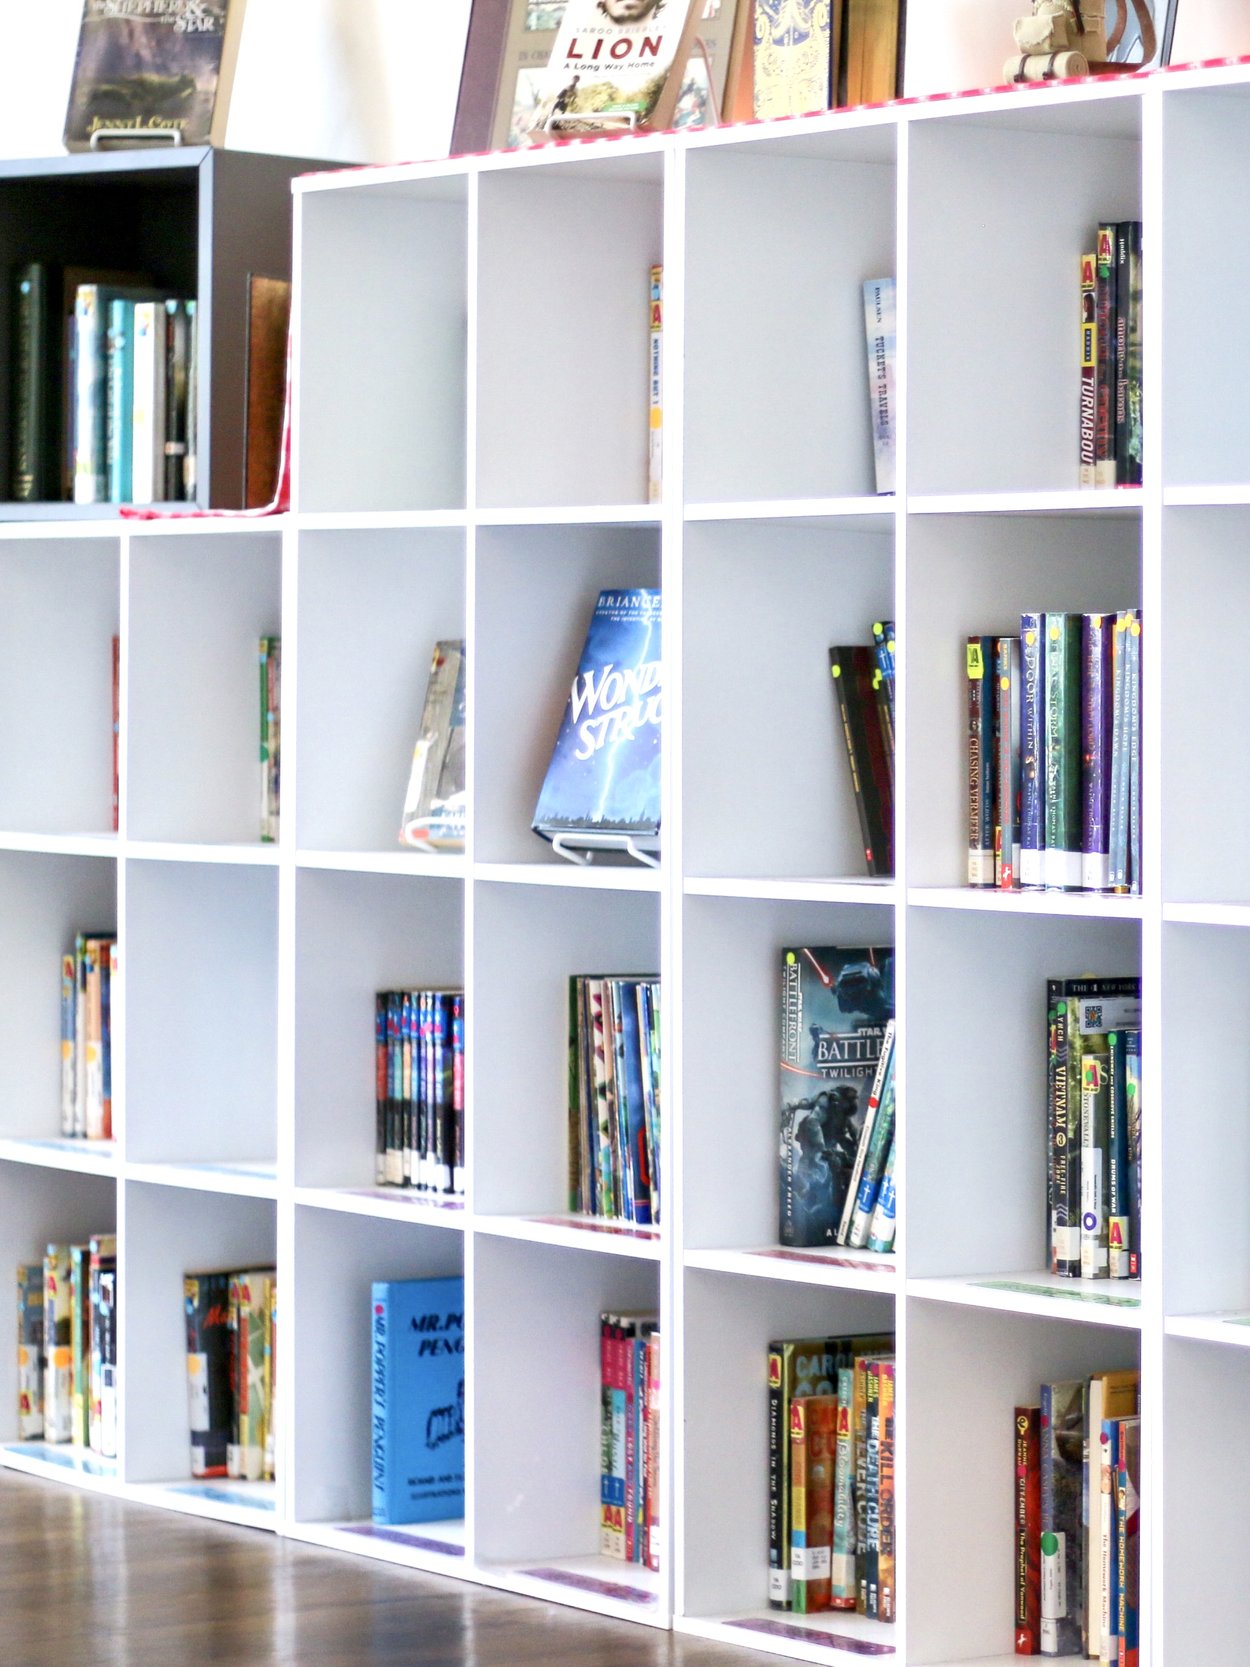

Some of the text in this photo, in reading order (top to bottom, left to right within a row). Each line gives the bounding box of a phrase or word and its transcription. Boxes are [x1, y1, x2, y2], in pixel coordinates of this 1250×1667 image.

[567, 36, 663, 60] LION
[574, 63, 600, 71] Long
[970, 737, 979, 840] CHASING VERMEER
[788, 962, 798, 1063] BATTLEFRONT
[1055, 1065, 1068, 1129] VIETNAM
[1110, 1159, 1118, 1214] DRUMS OF WAR
[770, 1399, 779, 1450] DIAMONDS
[770, 1475, 779, 1492] THE
[867, 1416, 881, 1552] THE DEATH CURE
[880, 1440, 894, 1486] KILL
[770, 1499, 779, 1540] SHADOW
[1019, 1532, 1027, 1546] The
[1017, 1546, 1027, 1576] Prophet
[1118, 1536, 1126, 1589] HOMEWORK
[1019, 1587, 1027, 1620] Yonwood
[1118, 1593, 1126, 1632] MACHINE
